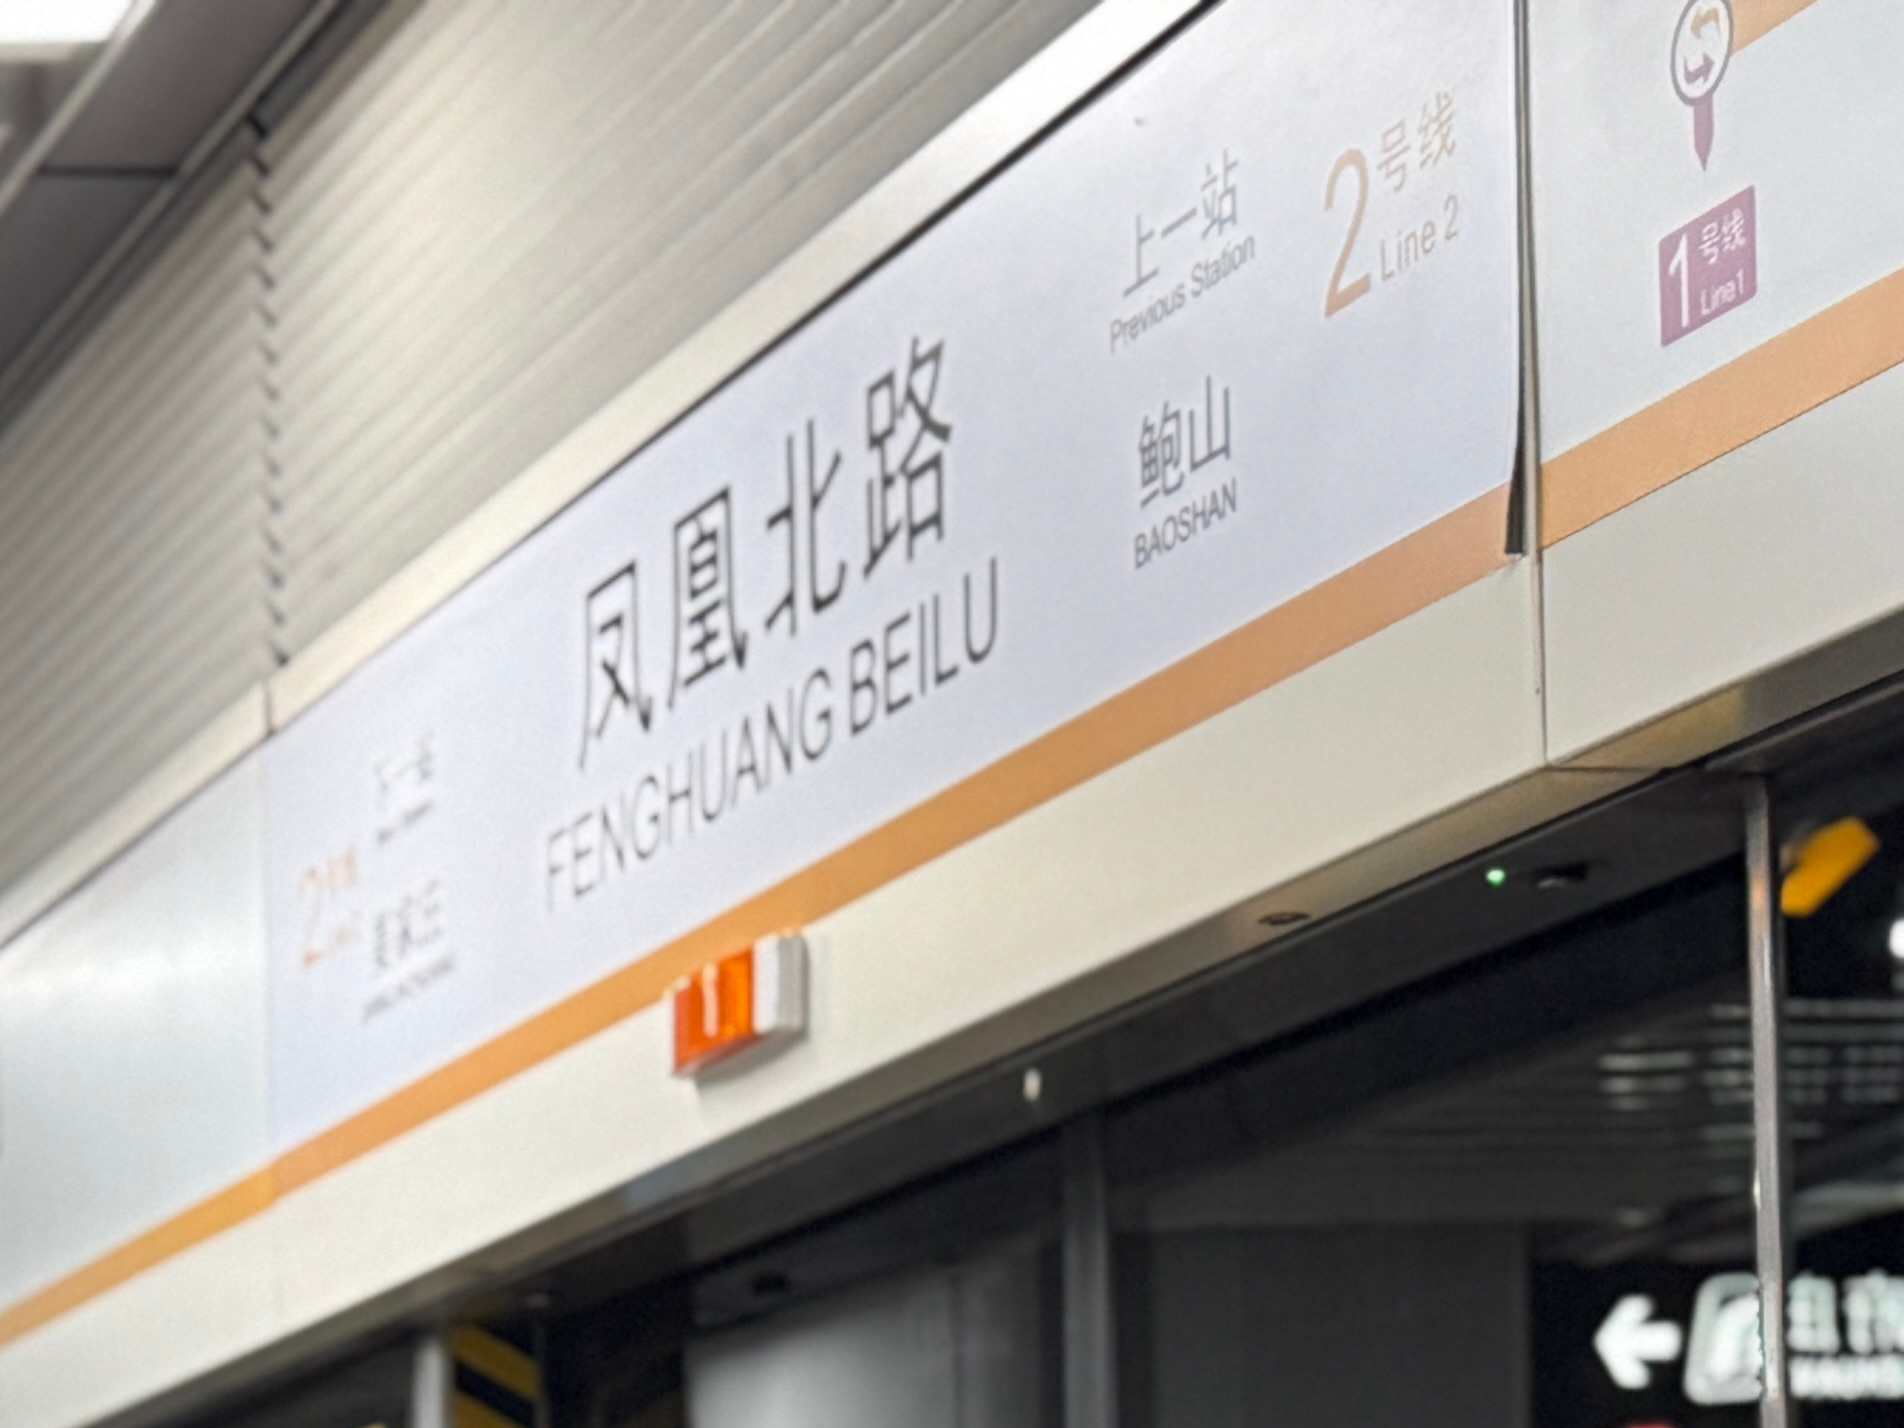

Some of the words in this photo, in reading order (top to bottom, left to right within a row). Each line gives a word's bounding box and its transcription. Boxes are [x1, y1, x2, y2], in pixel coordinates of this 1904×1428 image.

[1123, 147, 1240, 298] 上一站
[1323, 90, 1458, 320] 2号线
[1379, 217, 1436, 284] Line
[1443, 194, 1460, 244] 2
[1108, 281, 1187, 356] Previous
[1189, 233, 1256, 301] Station
[1137, 374, 1232, 510] 鲍山
[577, 335, 953, 772] 凤凰北路
[1133, 477, 1239, 571] BAOSHAN
[544, 666, 833, 916] FENGHUANG
[848, 555, 998, 738] BEILU
